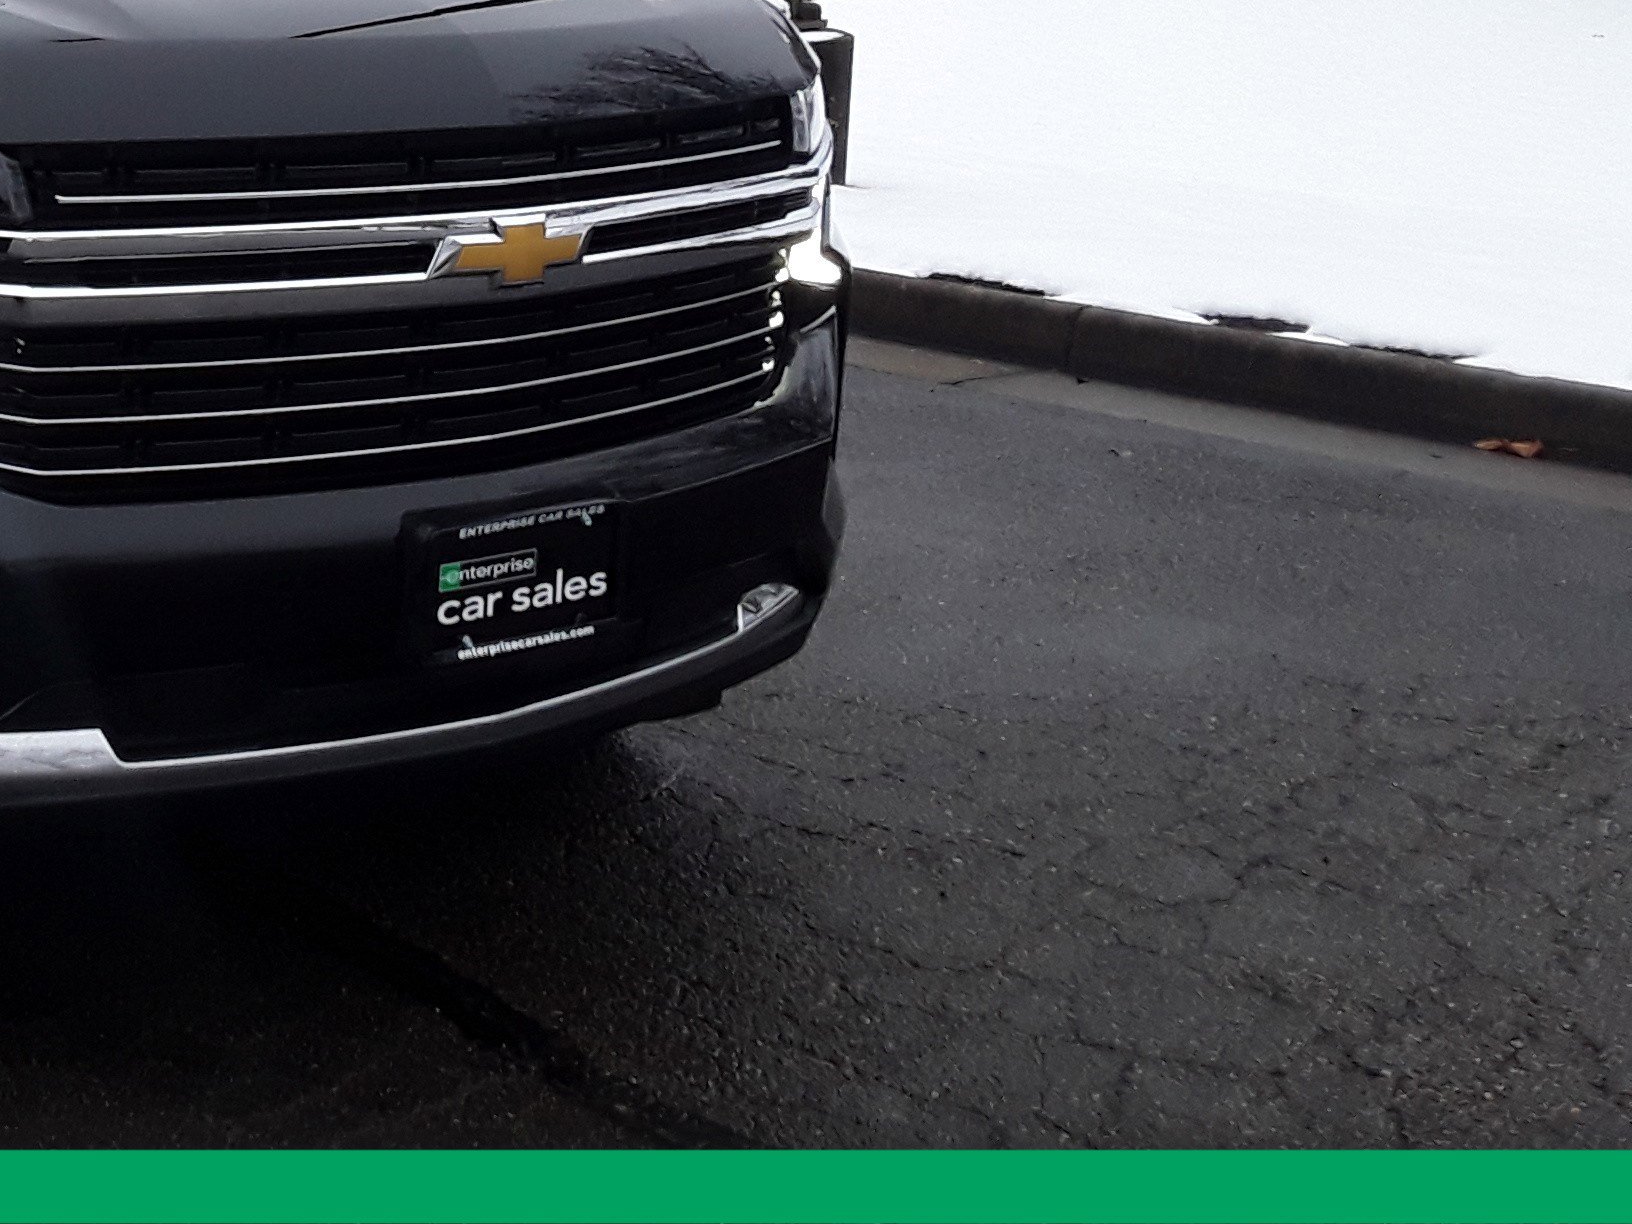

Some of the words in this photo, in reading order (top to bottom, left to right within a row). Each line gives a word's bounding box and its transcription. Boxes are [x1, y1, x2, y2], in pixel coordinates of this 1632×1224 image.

[459, 515, 536, 540] ENTERPRISE
[538, 510, 564, 524] CAR
[440, 557, 536, 584] enterprise
[437, 590, 503, 626] car
[511, 567, 608, 613] sales
